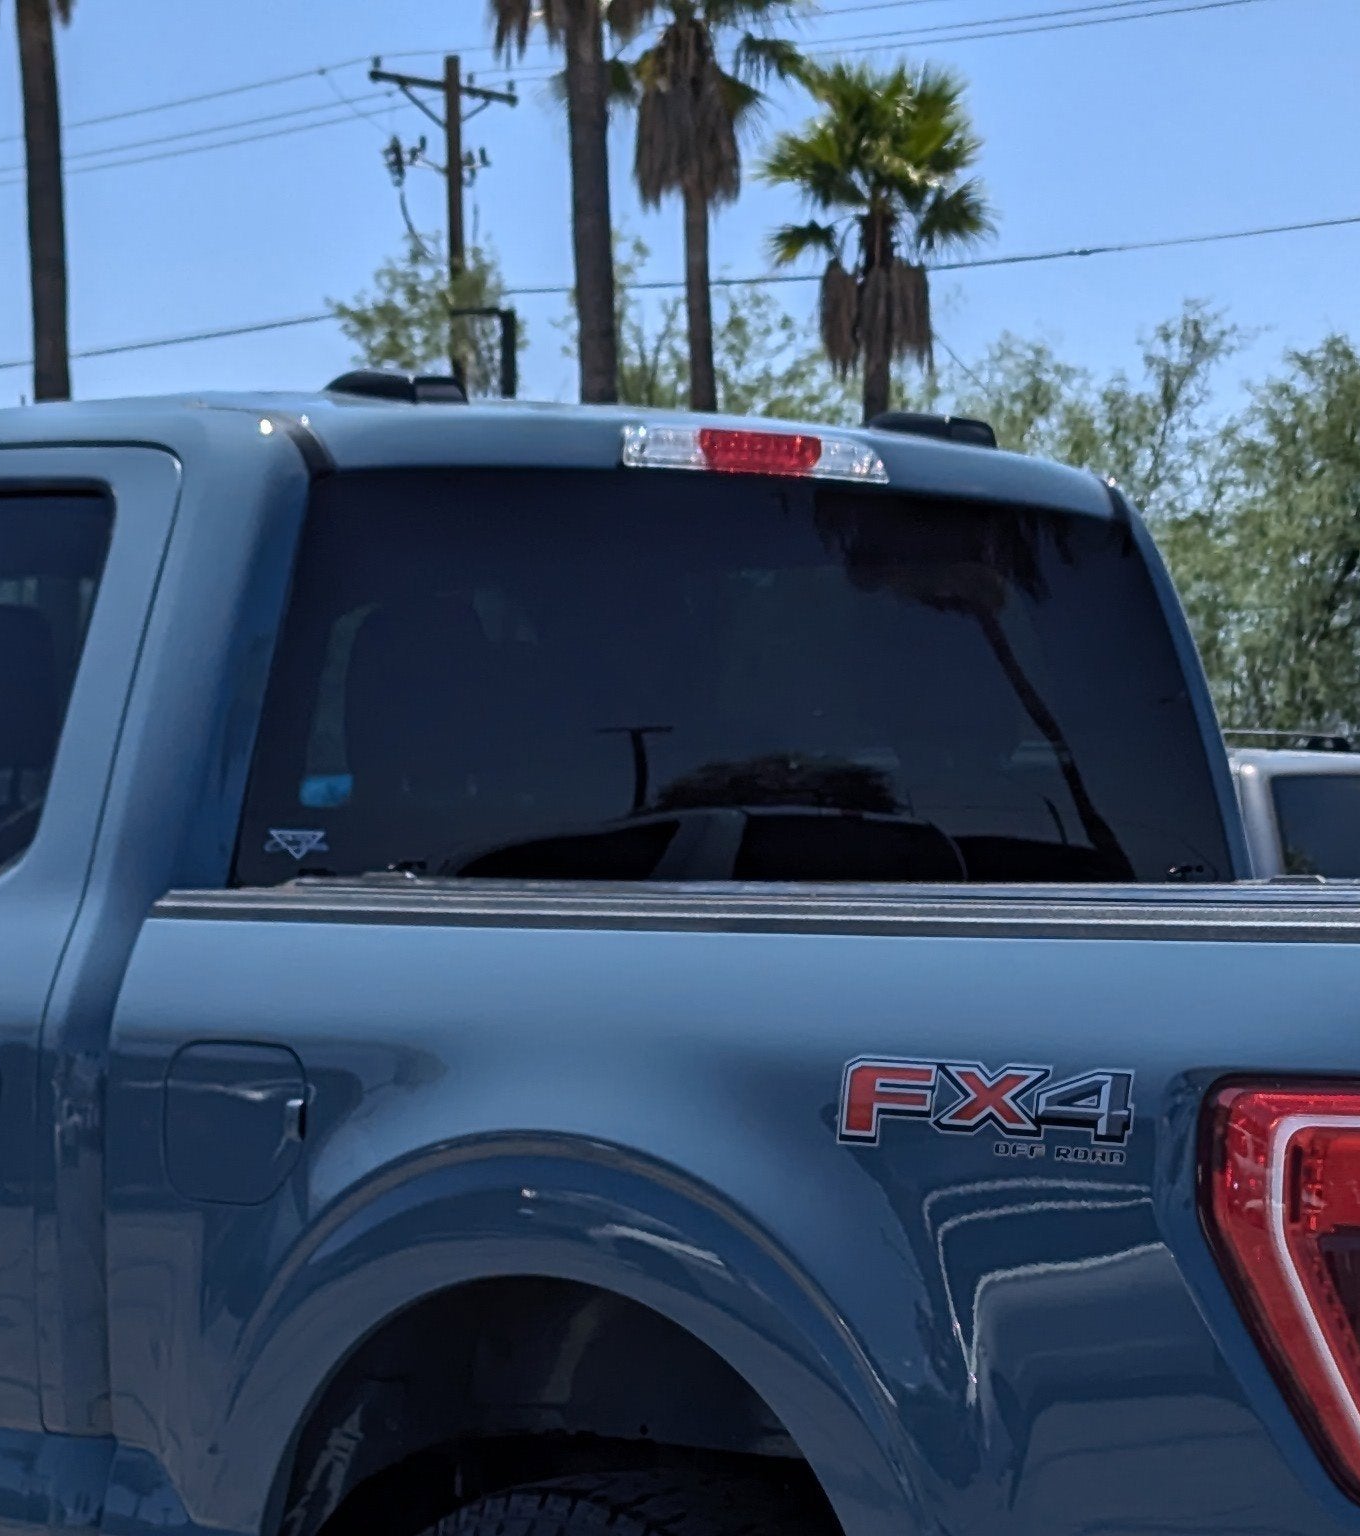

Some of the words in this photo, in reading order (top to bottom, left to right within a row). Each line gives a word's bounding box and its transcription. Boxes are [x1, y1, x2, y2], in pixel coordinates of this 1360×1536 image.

[837, 1055, 1135, 1146] FX4
[993, 1141, 1046, 1158] OFF
[1053, 1145, 1128, 1164] ROAD
